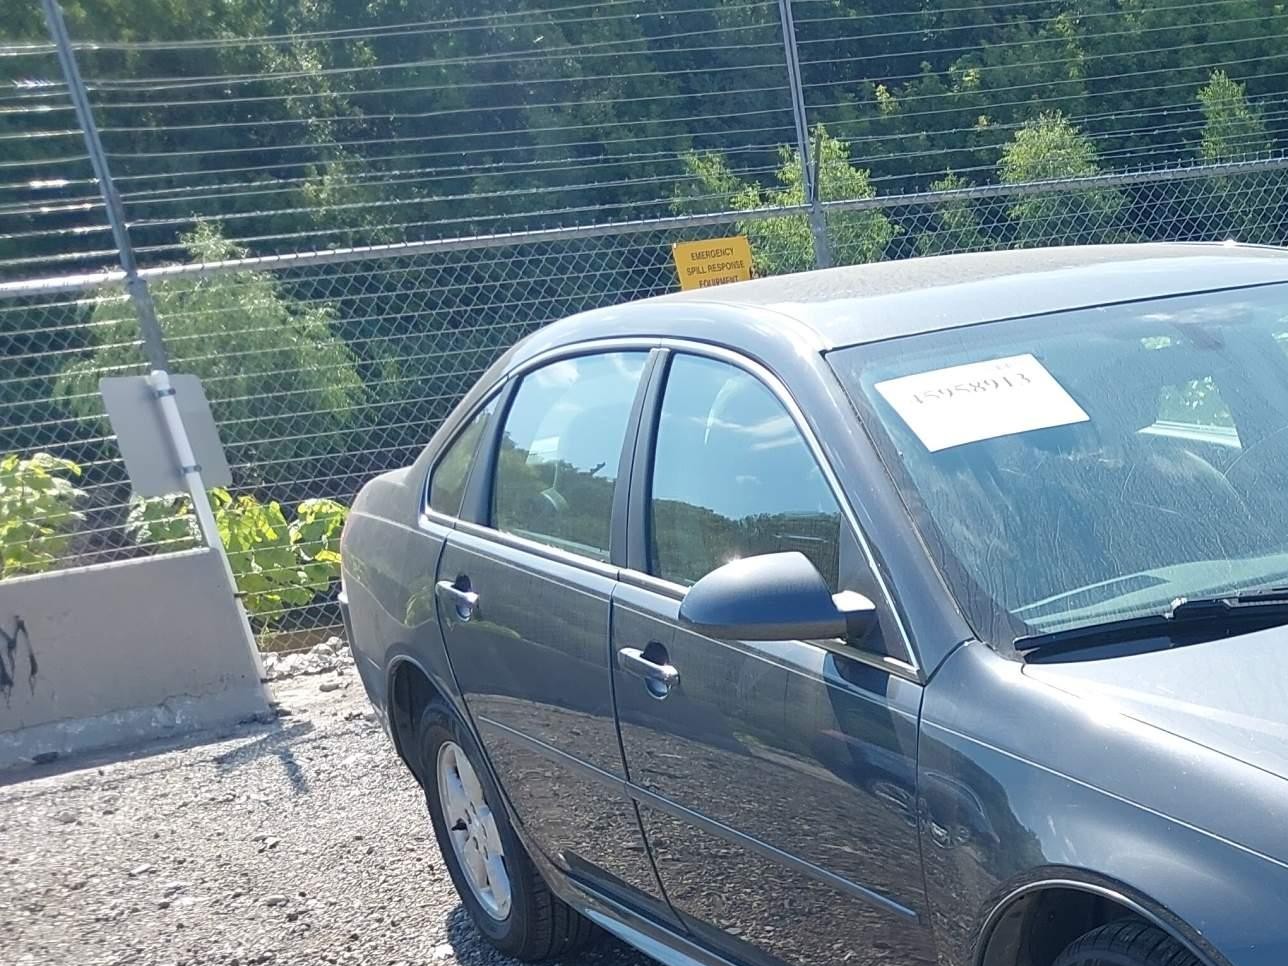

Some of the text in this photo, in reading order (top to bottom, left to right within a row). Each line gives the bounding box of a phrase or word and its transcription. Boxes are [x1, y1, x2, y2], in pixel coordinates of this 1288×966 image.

[691, 248, 734, 261] EMERGENCY
[687, 260, 745, 276] SPILL RESPONSE
